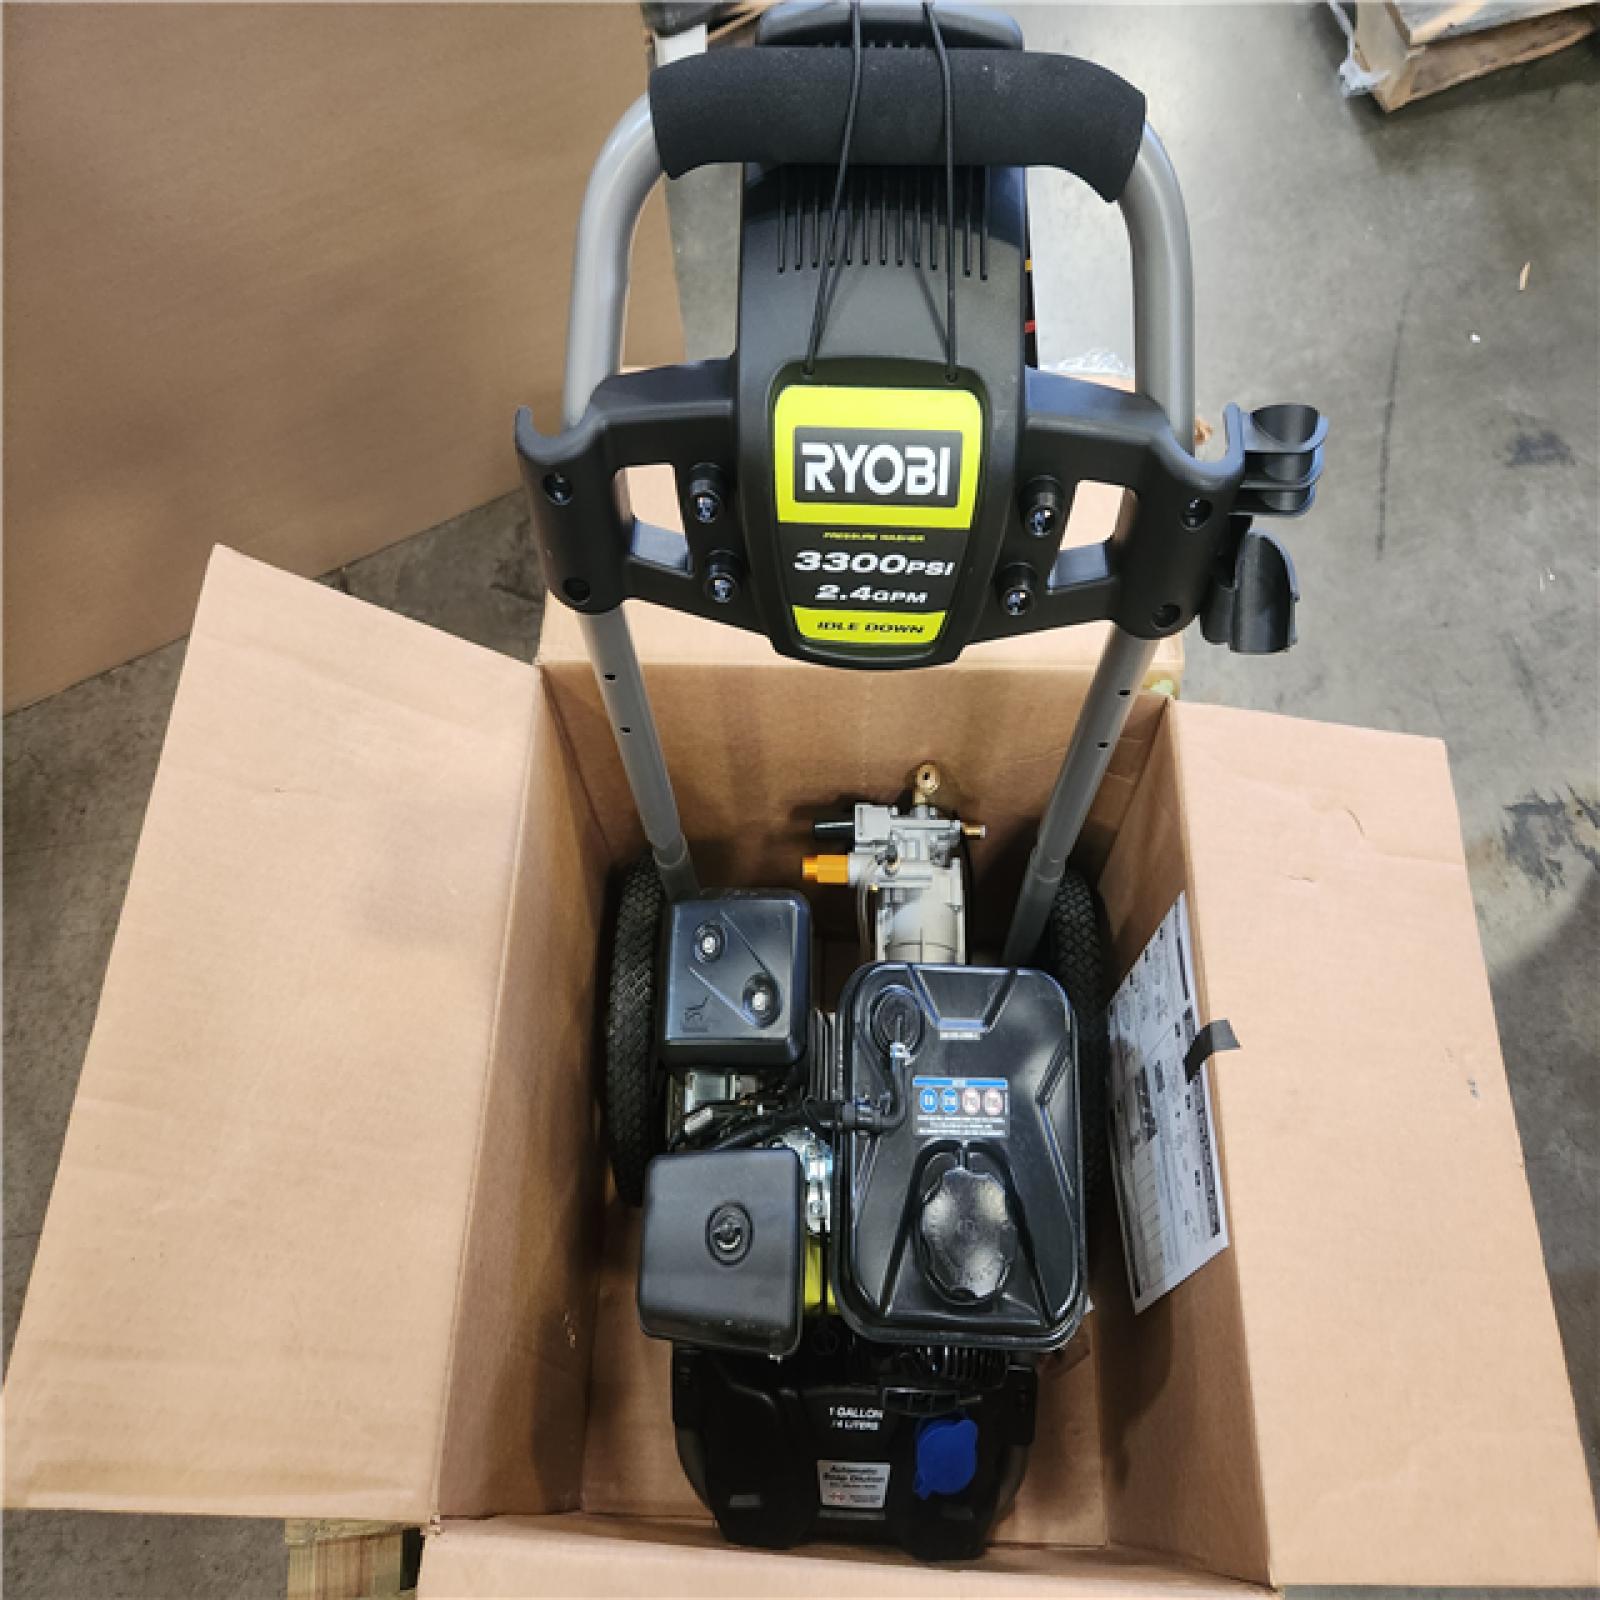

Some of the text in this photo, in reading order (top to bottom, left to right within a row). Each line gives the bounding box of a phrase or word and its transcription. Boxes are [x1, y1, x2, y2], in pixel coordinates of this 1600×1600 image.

[801, 442, 950, 496] RYOBI
[817, 621, 925, 634] IDLE DOWN
[836, 1406, 884, 1419] GALLON
